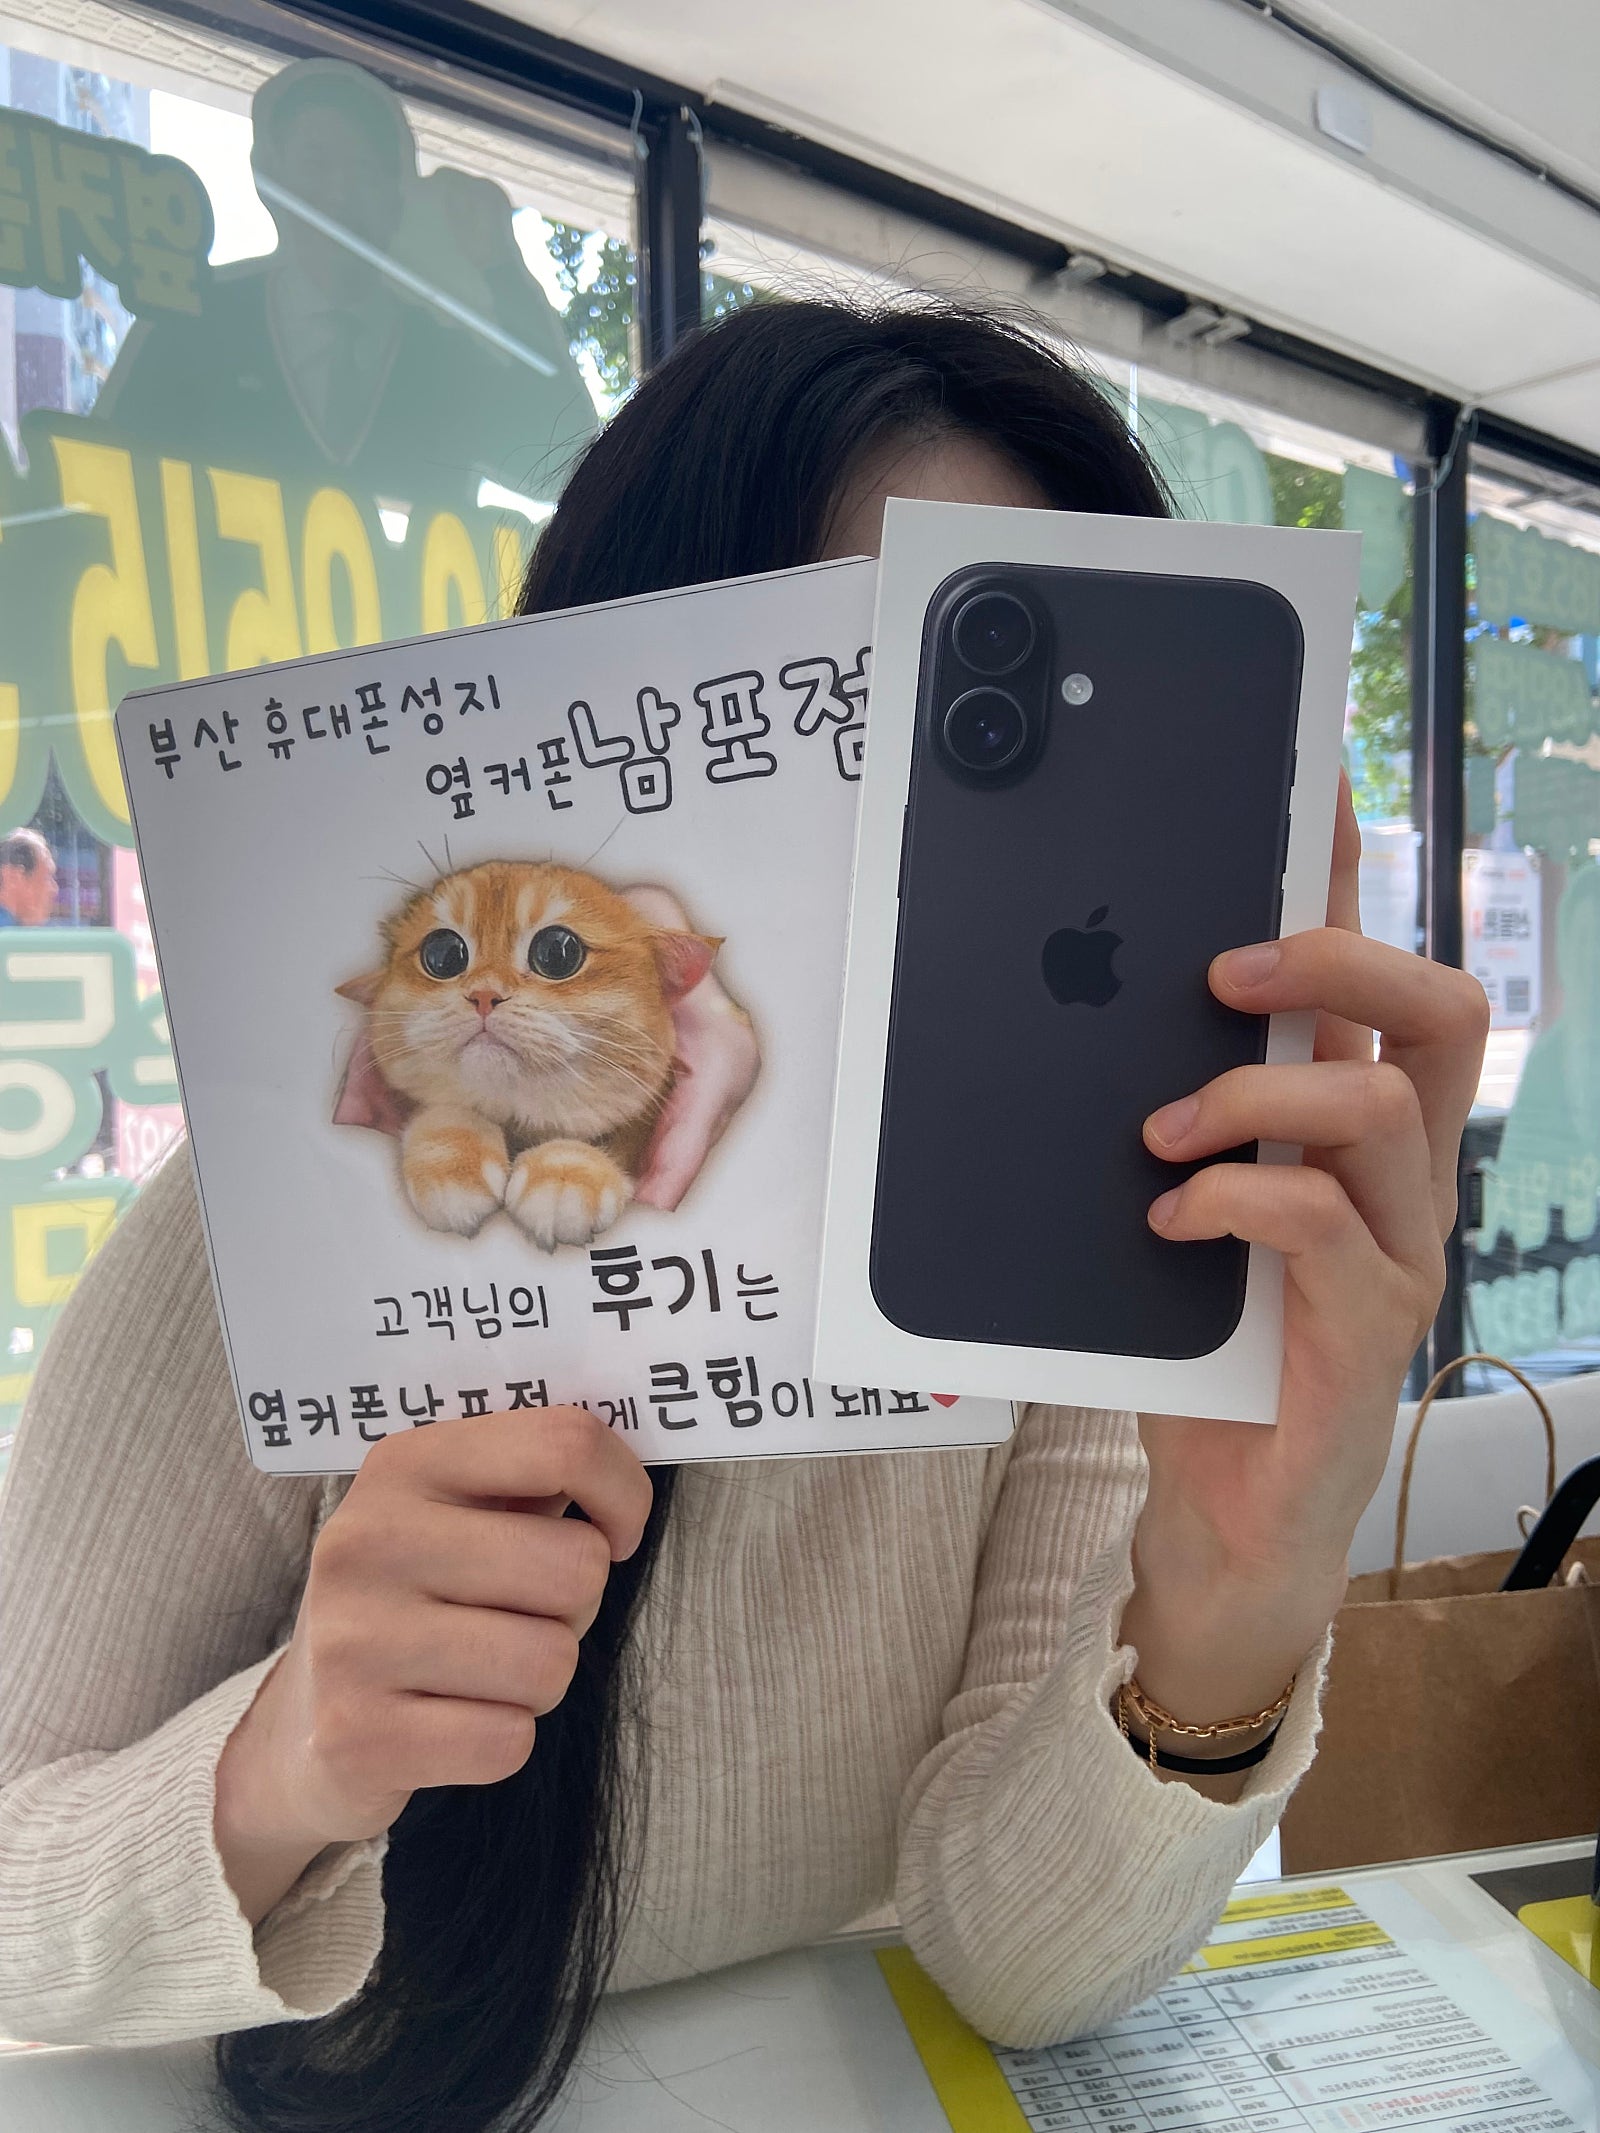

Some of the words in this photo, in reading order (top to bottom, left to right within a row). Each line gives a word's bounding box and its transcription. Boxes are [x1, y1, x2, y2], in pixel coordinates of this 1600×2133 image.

[150, 710, 243, 779] 부산
[264, 674, 501, 760] 휴대폰성지
[426, 737, 573, 819] 옆커폰
[374, 1282, 549, 1341] 고객님의
[589, 1245, 780, 1331] 후기는
